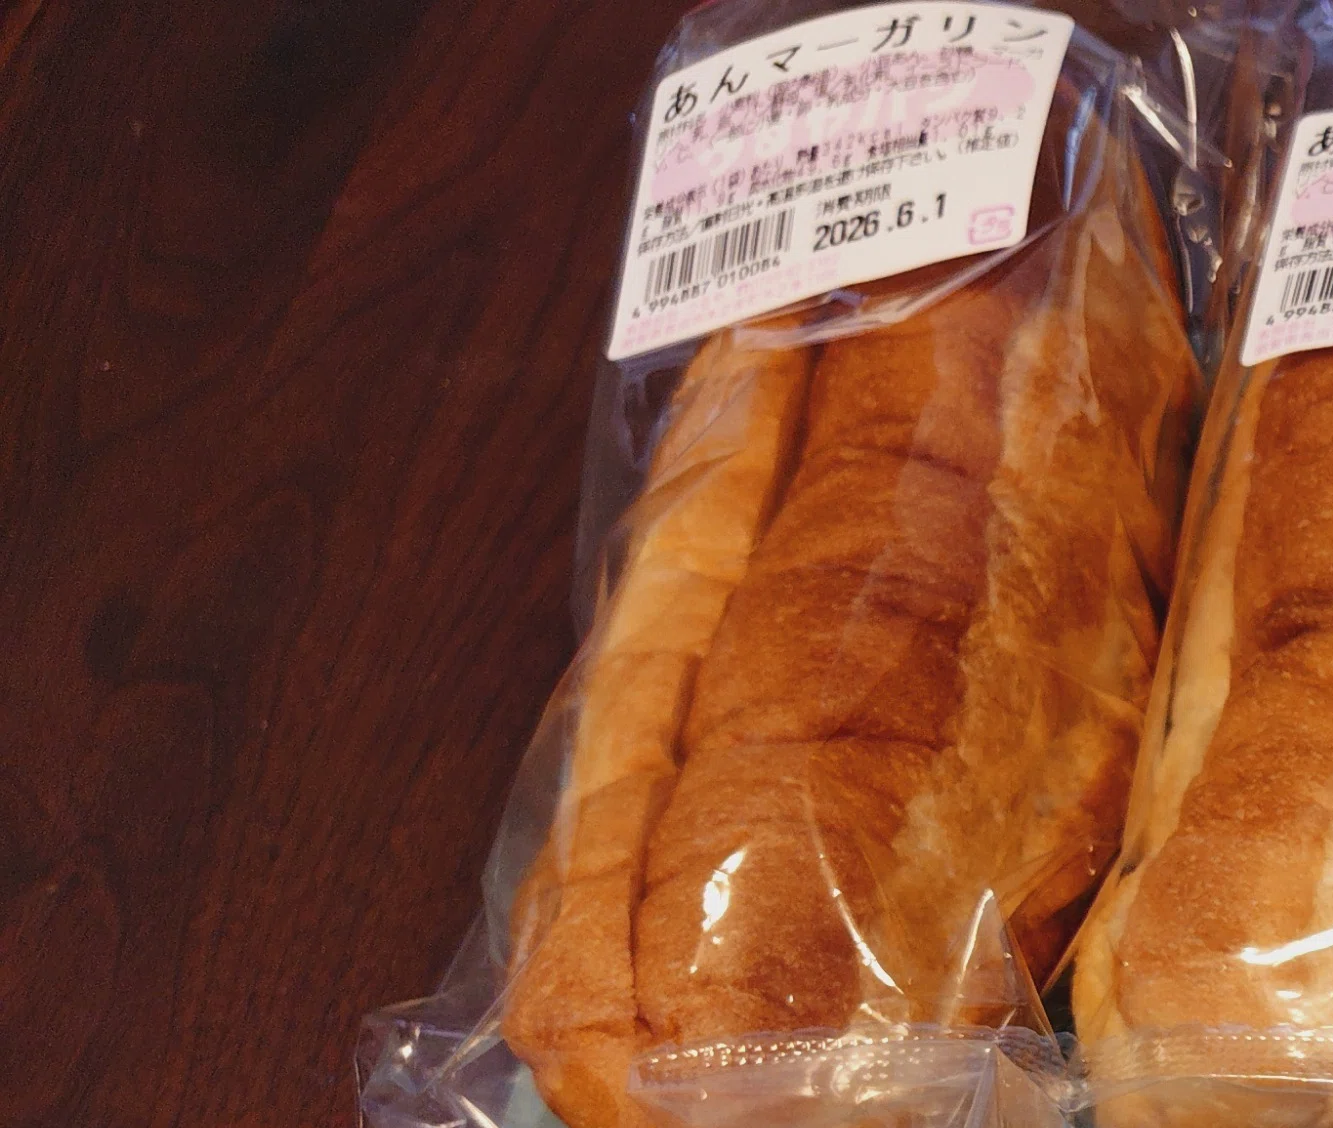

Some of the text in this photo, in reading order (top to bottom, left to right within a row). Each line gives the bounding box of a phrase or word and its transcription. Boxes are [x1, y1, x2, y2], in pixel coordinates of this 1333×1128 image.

[665, 14, 1047, 123] あんマーガリン
[813, 194, 946, 252] 2026.6.1
